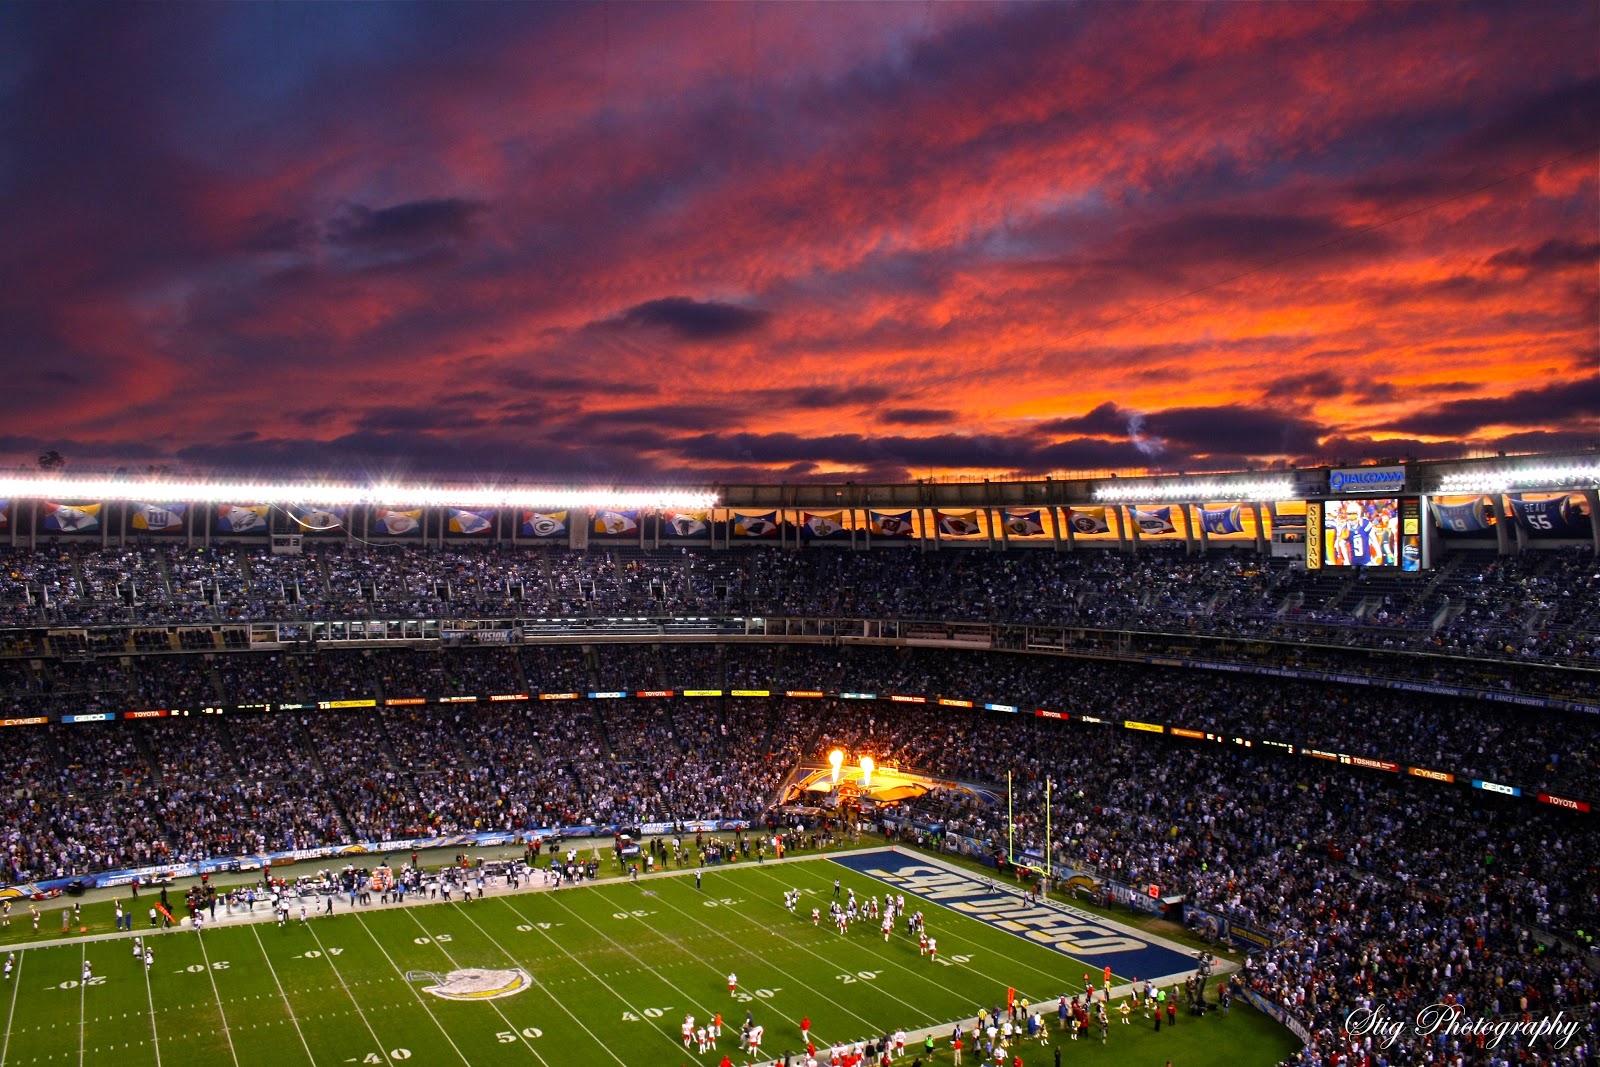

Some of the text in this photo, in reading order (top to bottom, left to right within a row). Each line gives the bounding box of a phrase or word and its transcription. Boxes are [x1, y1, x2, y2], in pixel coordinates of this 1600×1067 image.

[1330, 472, 1405, 491] QUALCOMM
[1524, 503, 1546, 513] SEAU
[1206, 513, 1225, 521] FOUTS
[1526, 514, 1553, 530] 55
[1448, 519, 1467, 532] 19
[1308, 506, 1318, 568] SYCUAN
[1494, 694, 1513, 703] LANCE
[1514, 698, 1544, 706] ALWORTH
[1584, 706, 1600, 714] RON
[4, 718, 42, 726] CYMER
[74, 714, 106, 722] GEICO
[1353, 757, 1381, 768] TOSHIBA
[1414, 768, 1448, 781] CYMER
[1482, 781, 1513, 794] GEICO
[1549, 796, 1578, 809] TOYOTA
[703, 898, 738, 908] 20
[613, 910, 649, 920] 30
[863, 866, 1148, 955] SAN DIEGO
[1043, 899, 1105, 921] SERVICE
[516, 922, 552, 932] 40
[414, 934, 453, 946] 50
[304, 947, 344, 958] 40
[187, 961, 231, 973] 30
[933, 955, 970, 967] 10
[835, 969, 878, 985] 20
[734, 988, 776, 1003] 30
[621, 1006, 664, 1022] 40
[495, 1027, 543, 1043] 50
[363, 1048, 412, 1065] 40
